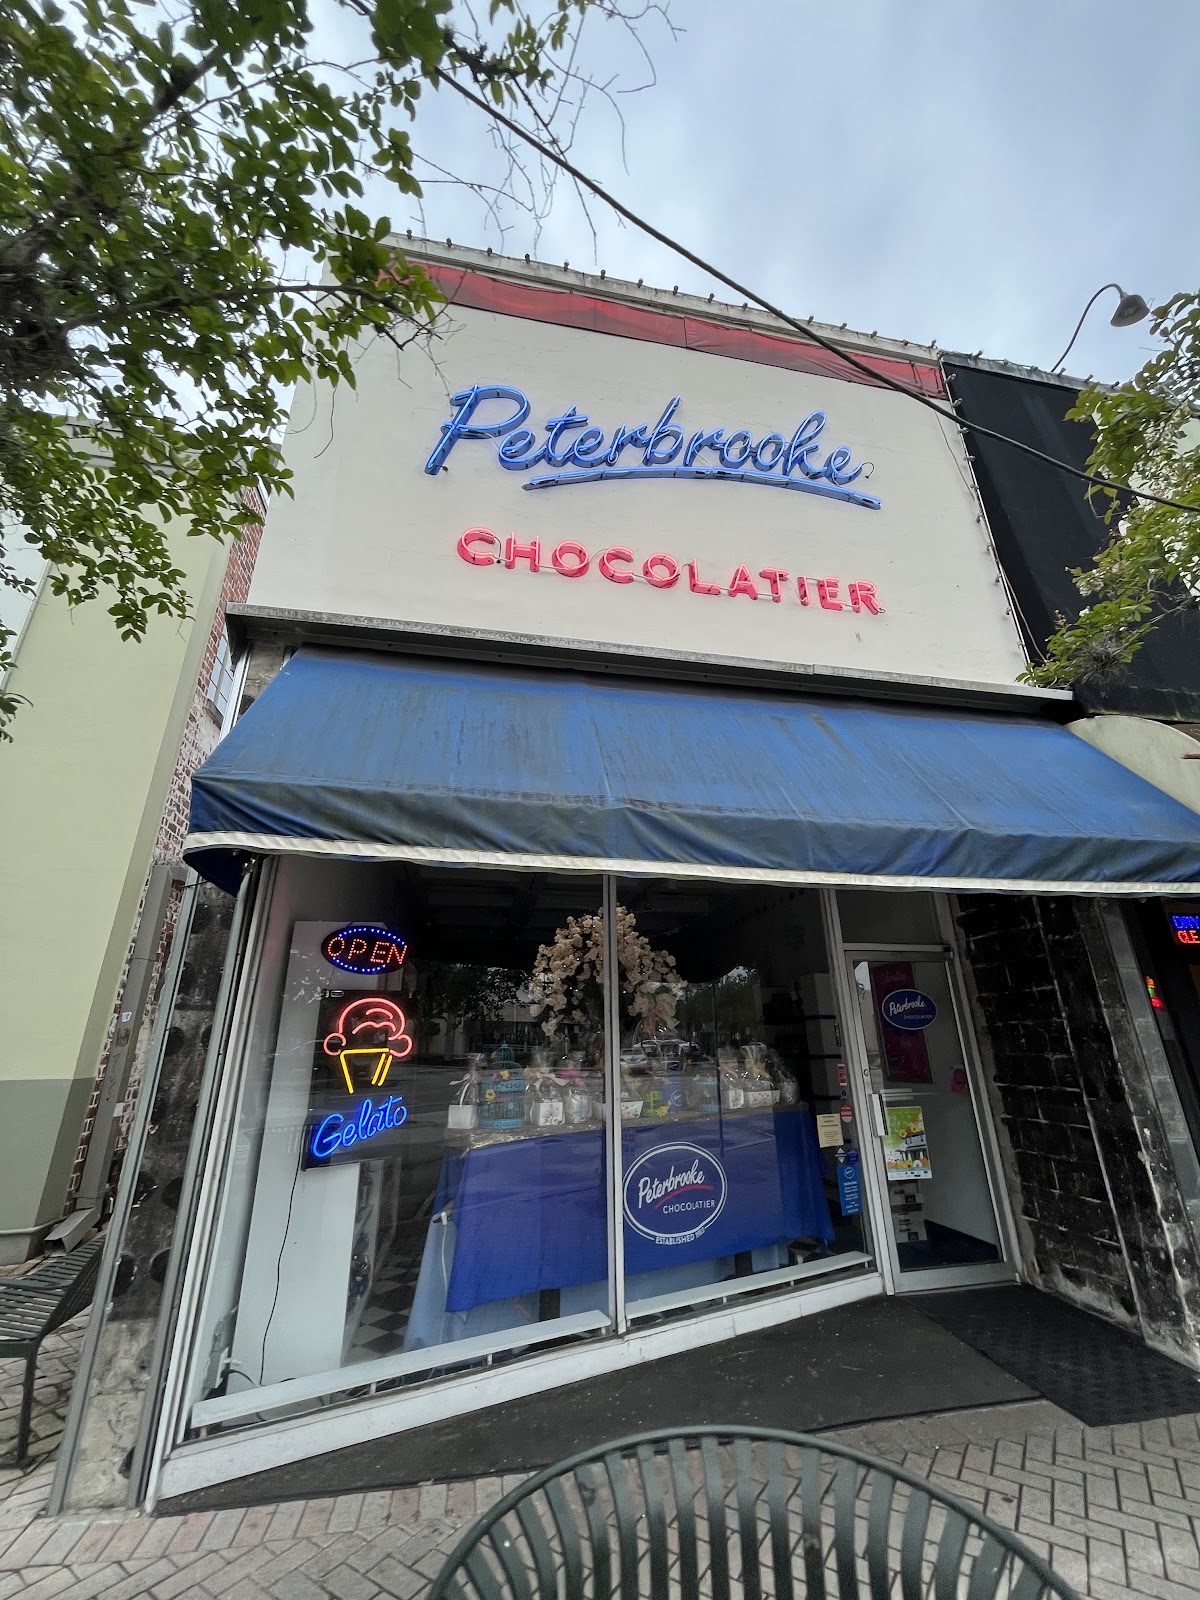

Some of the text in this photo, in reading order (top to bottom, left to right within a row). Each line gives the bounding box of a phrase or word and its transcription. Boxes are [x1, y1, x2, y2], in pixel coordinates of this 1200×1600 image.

[425, 384, 867, 485] Peterbrooke
[457, 526, 881, 615] CHOCOLATIER
[327, 936, 407, 964] OPEN
[889, 995, 926, 1016] Peterbrooke
[313, 1096, 407, 1158] Gelato
[638, 1159, 705, 1209] Peterbrooke
[662, 1199, 716, 1214] CHOCOLATIER
[655, 1234, 695, 1246] ESTABLISHED
